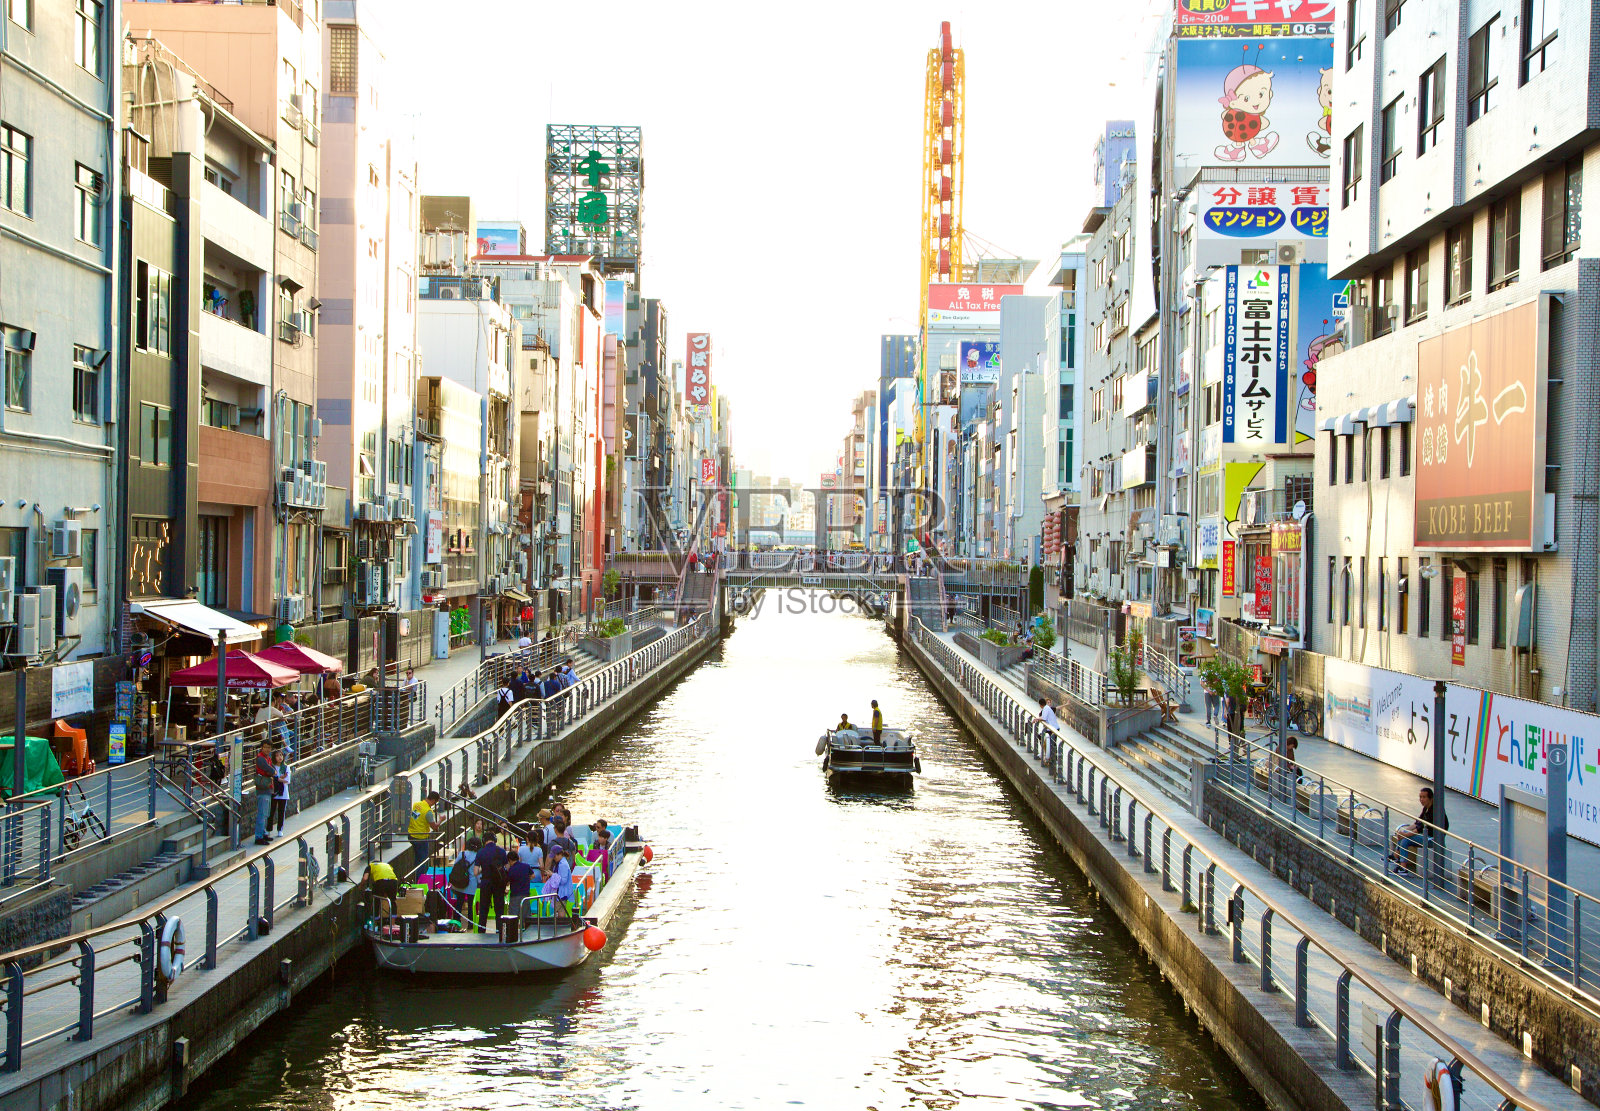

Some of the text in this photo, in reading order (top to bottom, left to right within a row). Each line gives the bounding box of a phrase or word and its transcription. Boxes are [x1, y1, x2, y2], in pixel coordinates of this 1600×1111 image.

[1291, 187, 1330, 206] 賃
[1210, 210, 1282, 227] マンション
[1296, 210, 1329, 226] レジ
[949, 301, 1000, 310] ALL Tax Free
[1428, 500, 1513, 535] KOBE BEEF
[1407, 701, 1471, 766] ようそ!
